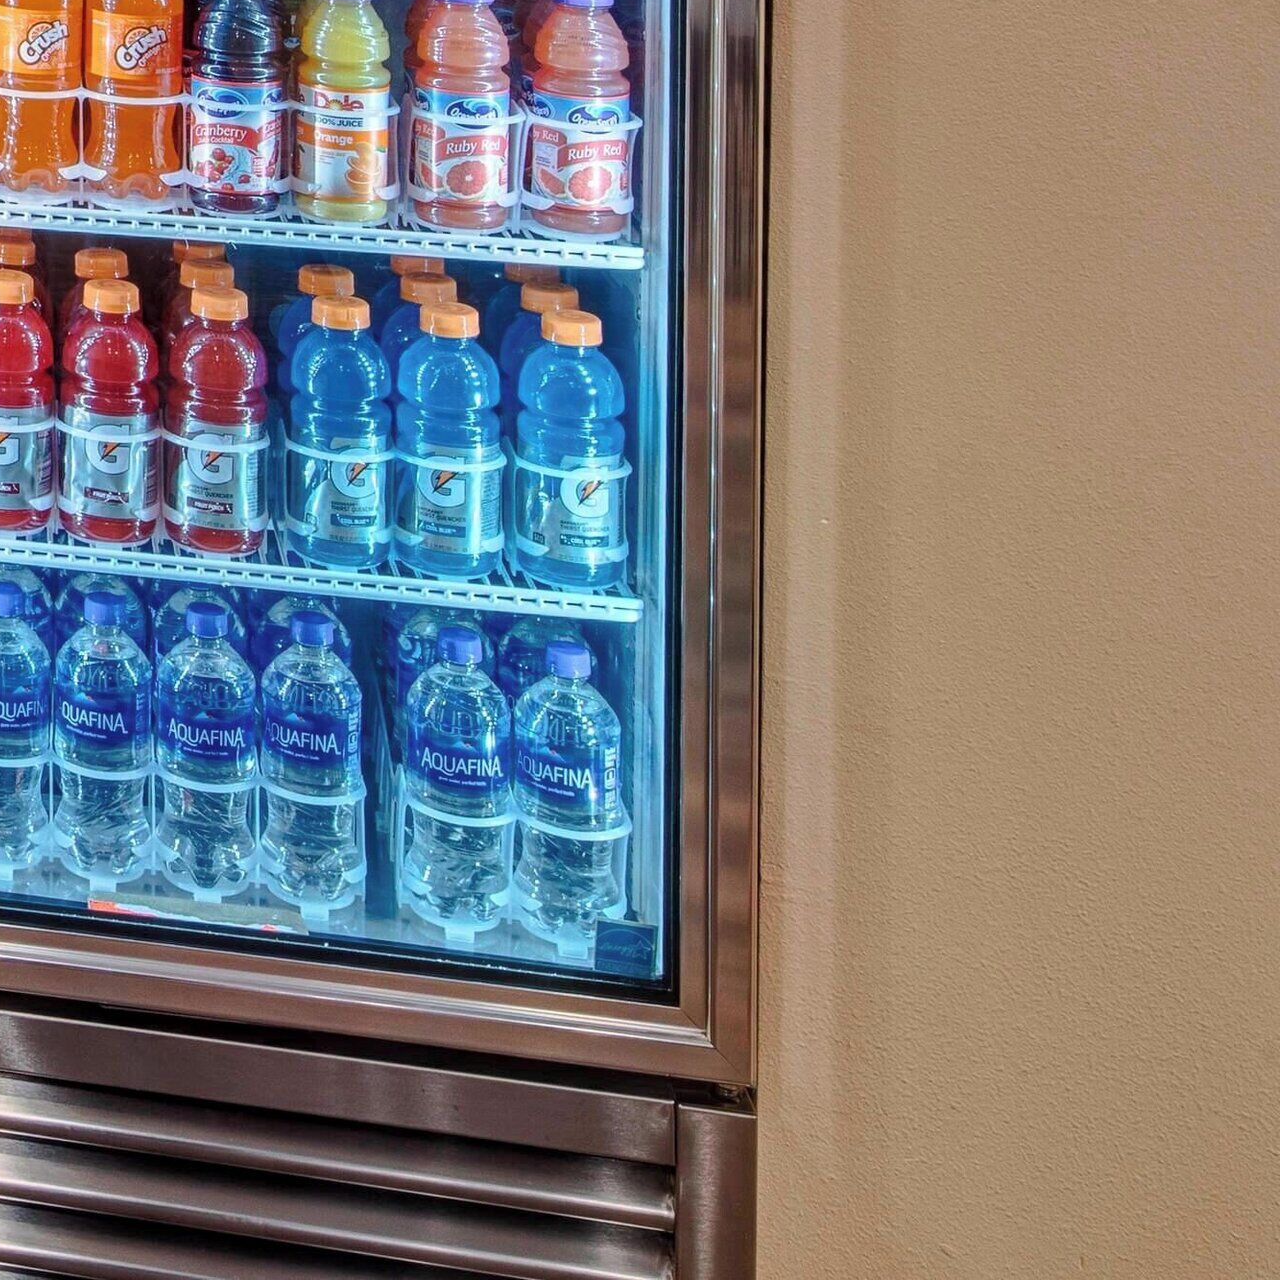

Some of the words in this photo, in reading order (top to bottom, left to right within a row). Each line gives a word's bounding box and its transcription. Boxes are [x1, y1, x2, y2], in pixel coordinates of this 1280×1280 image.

[18, 20, 69, 65] Crush
[115, 25, 167, 70] Crush
[314, 91, 364, 111] Dole
[195, 125, 248, 142] Cranberry
[336, 119, 364, 128] JUICE
[314, 131, 354, 146] Orange
[446, 141, 477, 156] Ruby
[480, 139, 501, 152] Red
[568, 145, 598, 161] Ruby
[603, 143, 623, 157] Red
[168, 717, 246, 748] AQUAFINA
[265, 721, 341, 754] AQUAFINA
[421, 746, 504, 778] AQUAFINA
[517, 751, 593, 790] AQUAFINA
